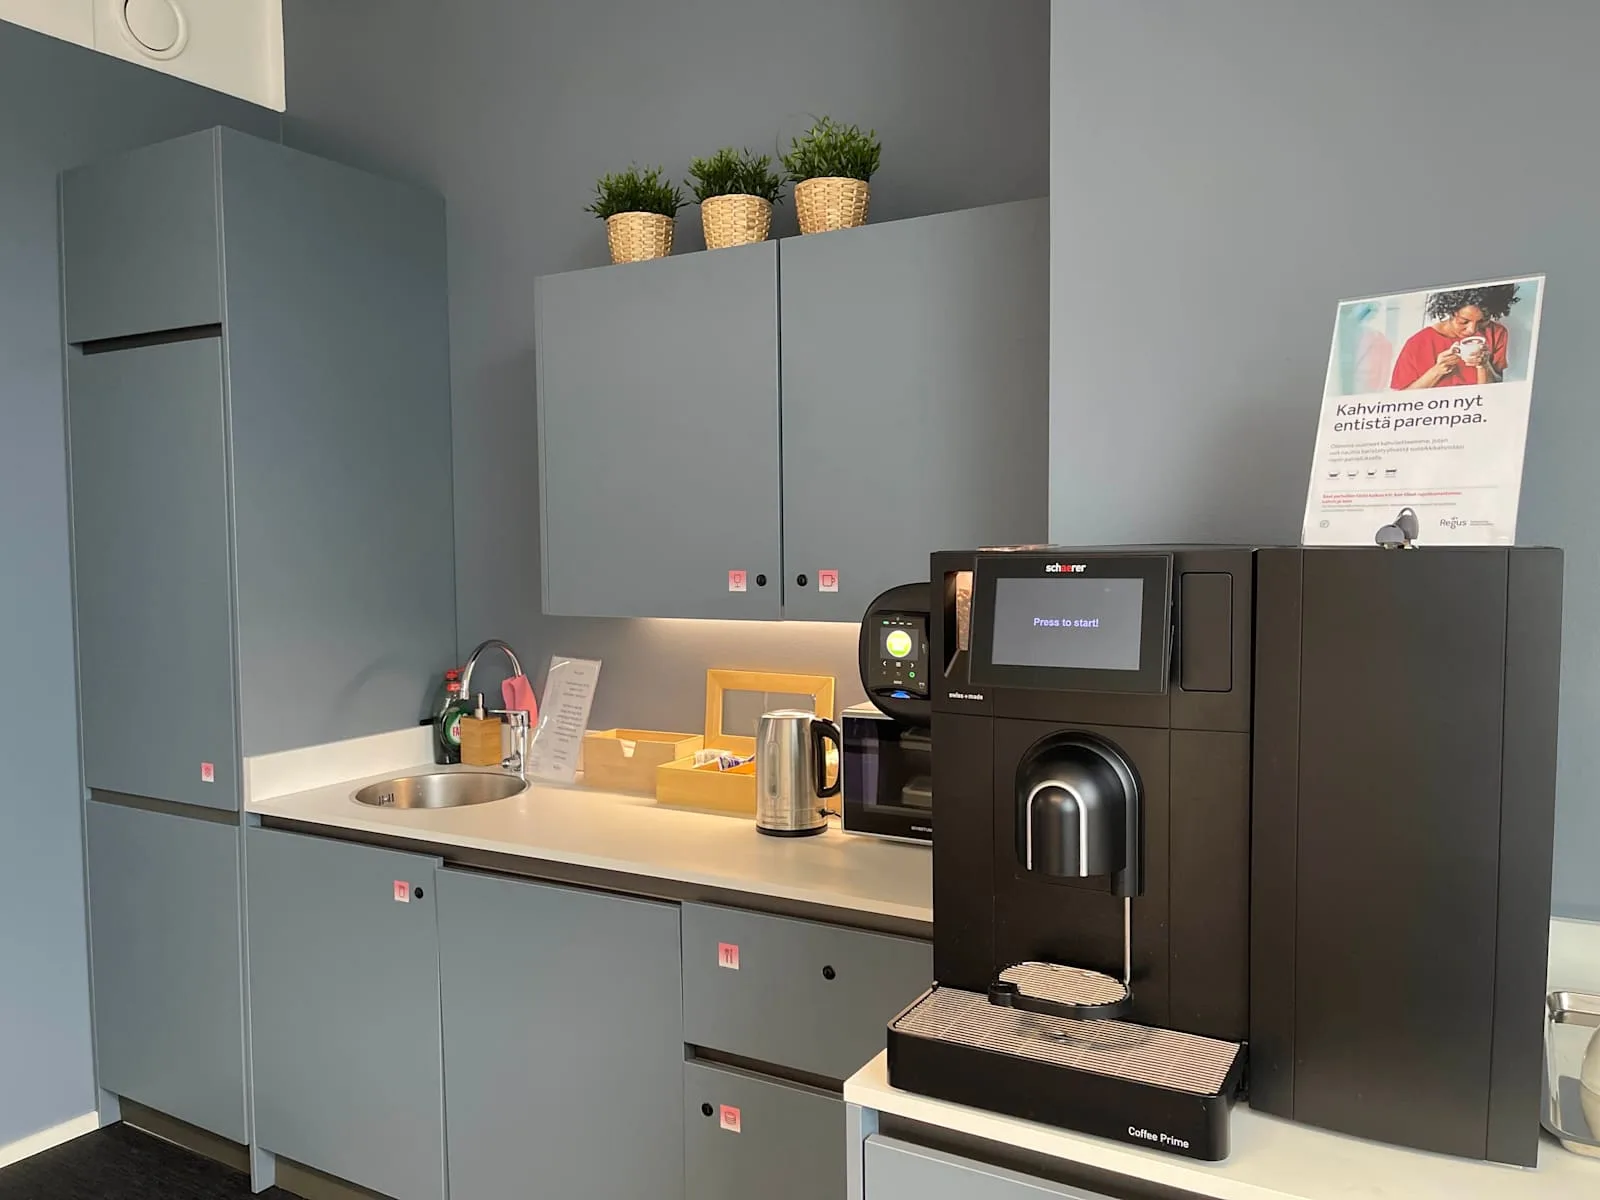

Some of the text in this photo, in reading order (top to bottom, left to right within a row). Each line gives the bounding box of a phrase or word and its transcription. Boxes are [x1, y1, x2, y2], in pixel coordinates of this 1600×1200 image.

[1336, 395, 1484, 417] Kahvimme on nyt
[1333, 413, 1488, 432] entistä parempaa.
[1439, 518, 1467, 529] Regus
[1045, 562, 1087, 573] schaerer
[1033, 617, 1099, 628] Press to start!
[1128, 1126, 1190, 1148] Coffee Prime
